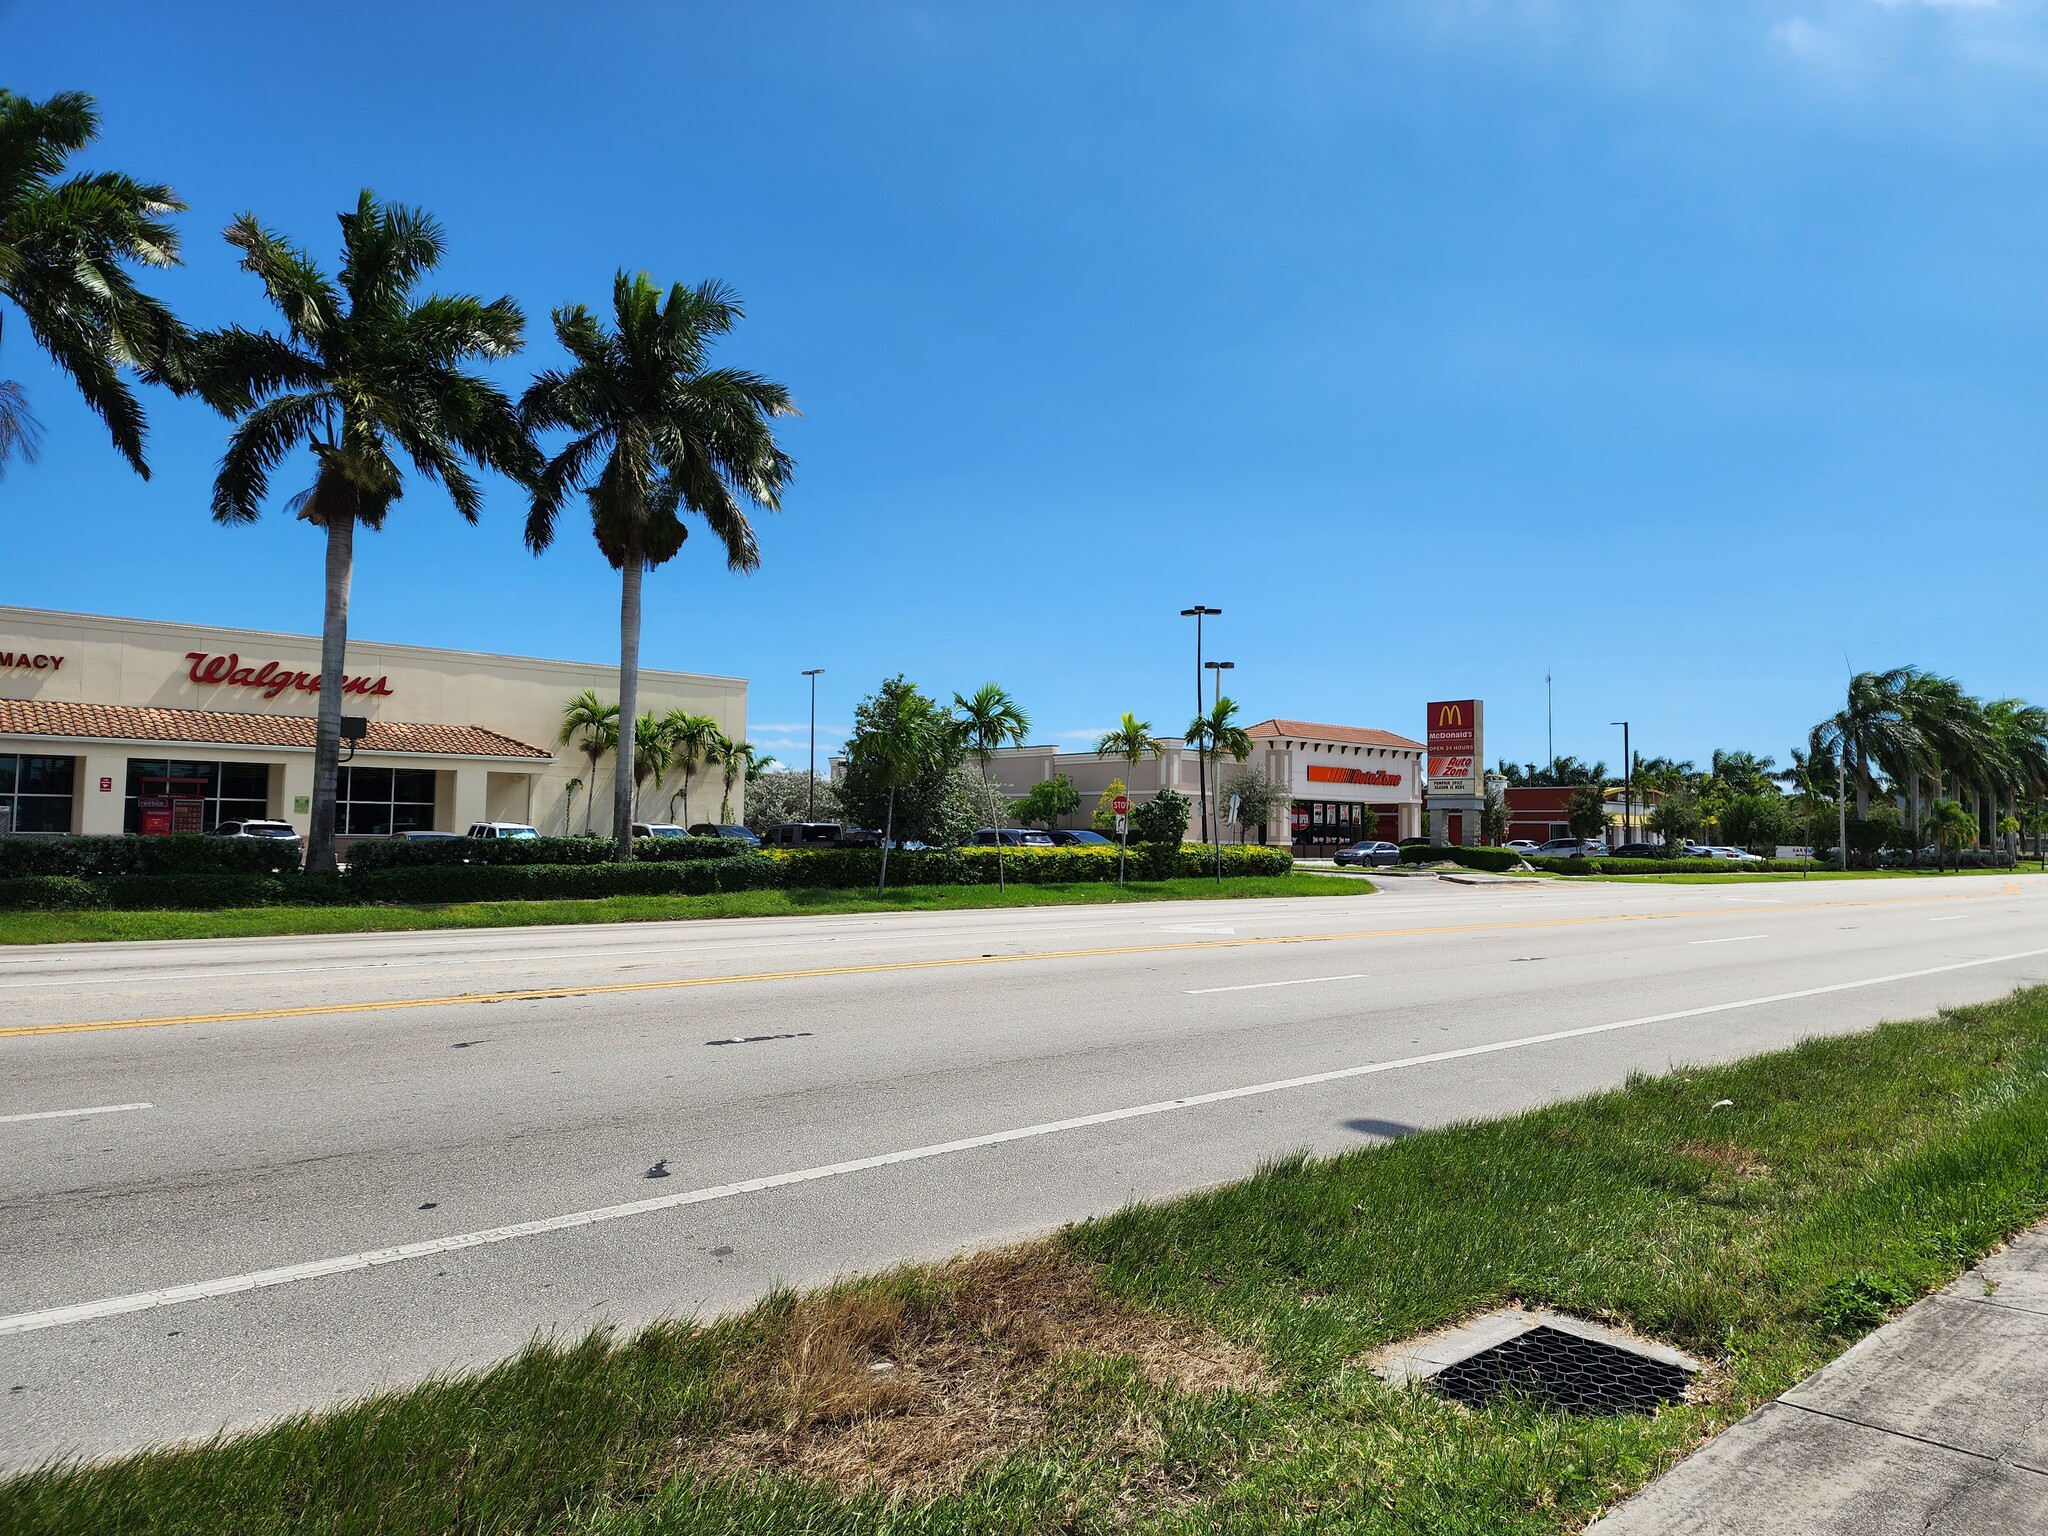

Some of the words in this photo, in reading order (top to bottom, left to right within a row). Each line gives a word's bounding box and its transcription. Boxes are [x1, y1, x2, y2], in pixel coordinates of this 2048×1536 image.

[0, 651, 65, 670] MACY
[185, 652, 394, 699] Walgrens
[1429, 731, 1473, 739] McDonald's
[1447, 756, 1472, 767] Auto
[1443, 766, 1469, 777] Zone
[1352, 769, 1402, 787] AutoZone
[1113, 801, 1127, 809] STO
